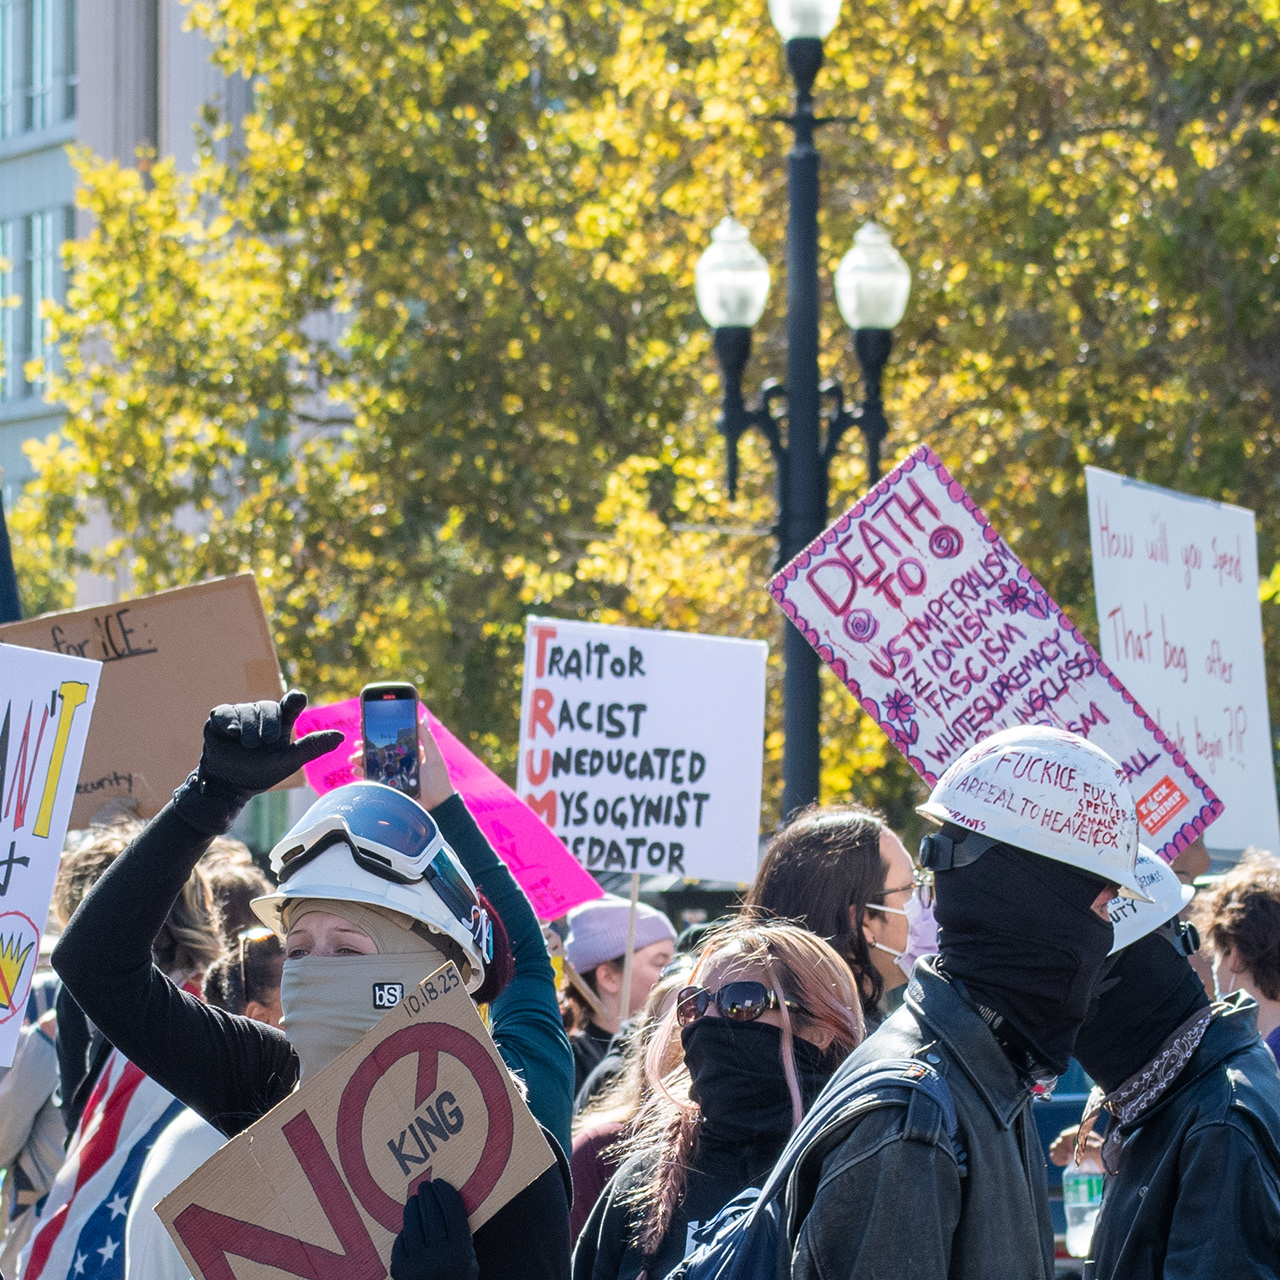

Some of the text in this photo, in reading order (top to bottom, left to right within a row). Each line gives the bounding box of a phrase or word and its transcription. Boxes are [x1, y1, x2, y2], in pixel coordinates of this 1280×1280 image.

[806, 477, 941, 617] DEATH
[1097, 495, 1134, 559] How
[1146, 522, 1169, 564] will
[873, 557, 927, 608] TO
[532, 625, 646, 680] TRAITOR
[902, 599, 1006, 695] ZIONISM
[1107, 603, 1152, 664] That
[924, 623, 1027, 714] FASCISM
[528, 688, 647, 739] RACIST
[525, 748, 707, 786] UNEDUCATED
[525, 790, 710, 829] MYSOGYNIST
[1021, 797, 1040, 819] TO
[1078, 799, 1128, 823] SPENCER
[1083, 782, 1119, 808] FUCK
[1144, 791, 1183, 829] TRUMP
[559, 836, 685, 874] EDATOR
[402, 966, 461, 1019] 10.18.25
[387, 1091, 464, 1176] KING
